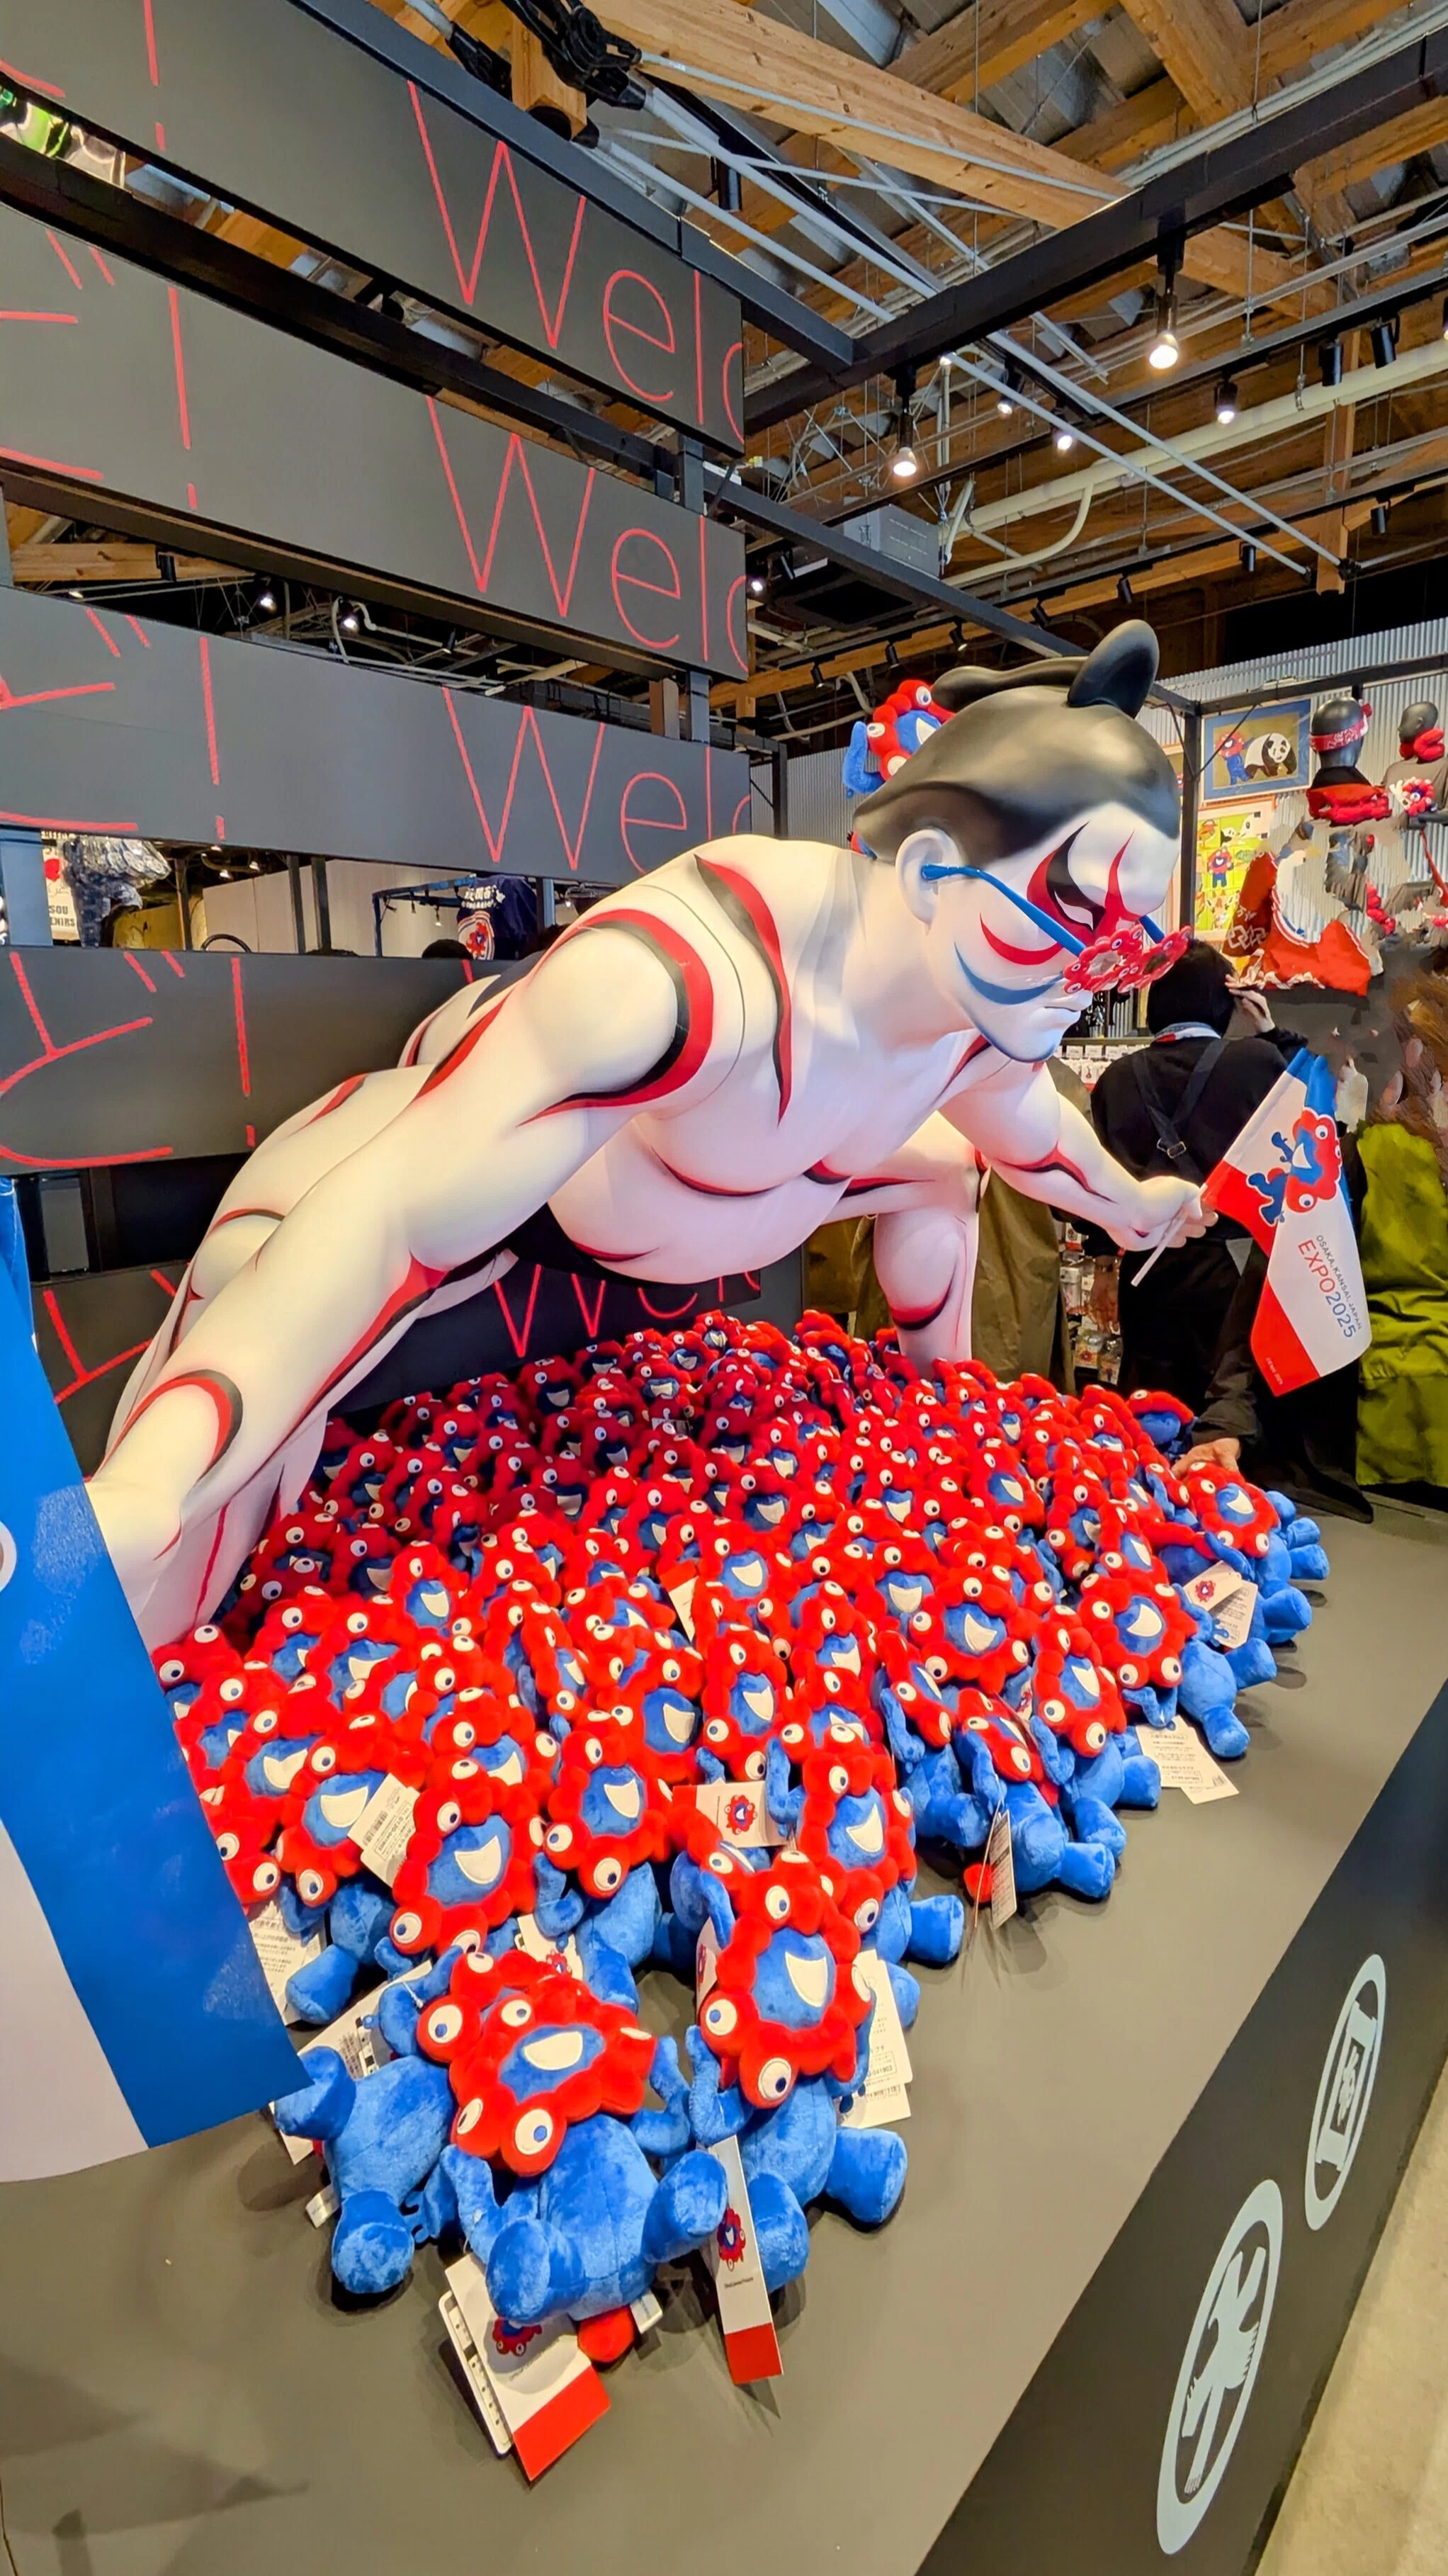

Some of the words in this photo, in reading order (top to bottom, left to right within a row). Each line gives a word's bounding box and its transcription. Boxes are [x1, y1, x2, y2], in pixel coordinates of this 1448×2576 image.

[442, 687, 751, 875] Wel
[50, 917, 75, 927] ENIRS
[1316, 1235, 1334, 1267] OSAKA,
[1349, 1303, 1362, 1330] JAPAN
